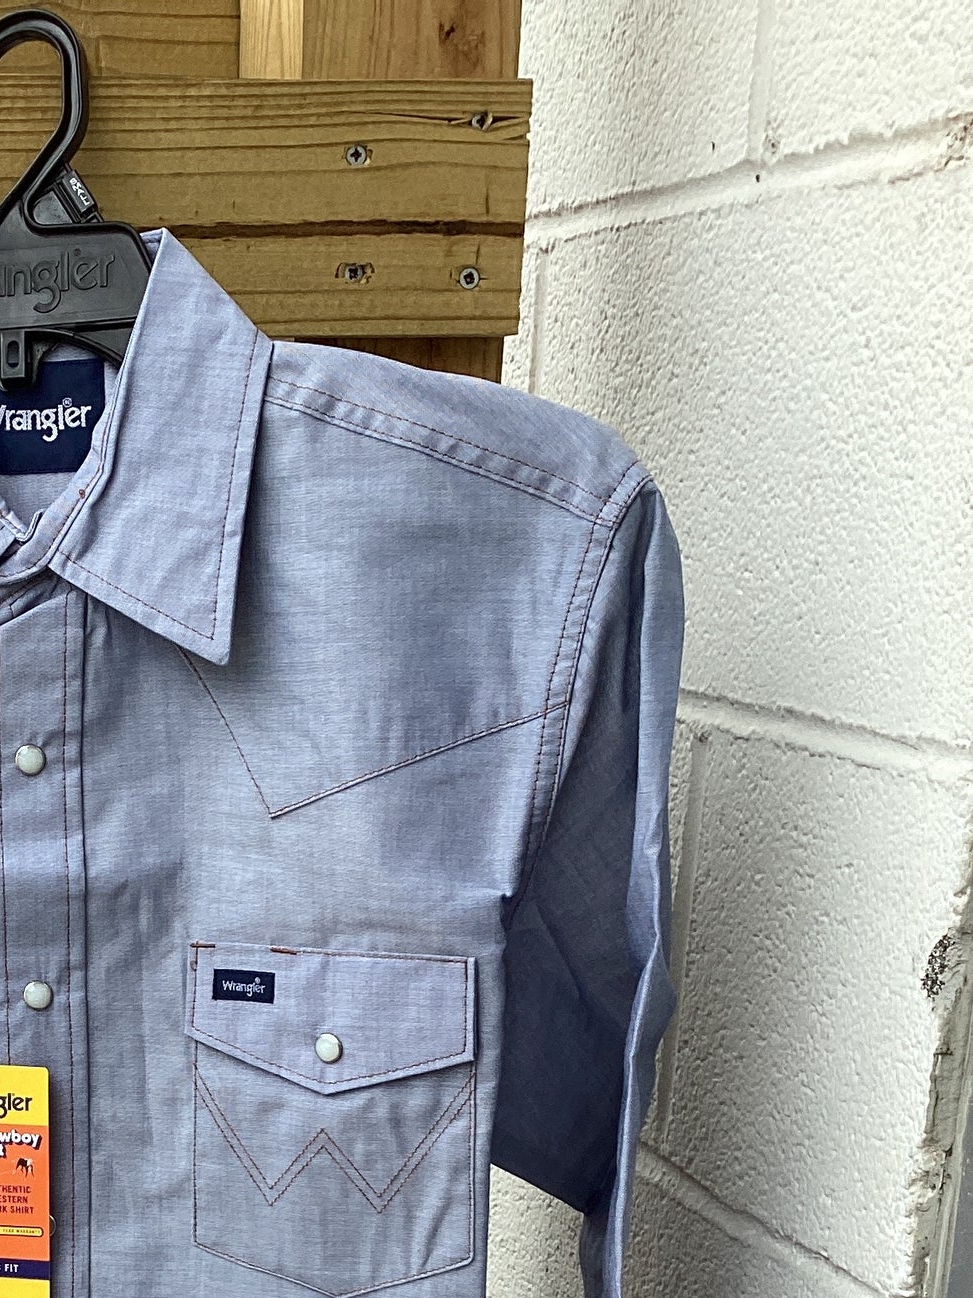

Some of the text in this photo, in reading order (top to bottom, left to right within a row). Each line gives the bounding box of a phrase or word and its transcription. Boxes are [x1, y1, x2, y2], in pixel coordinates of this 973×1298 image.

[222, 979, 266, 997] Wrangler
[10, 1205, 34, 1214] SHIRT
[4, 1263, 19, 1273] FIT
